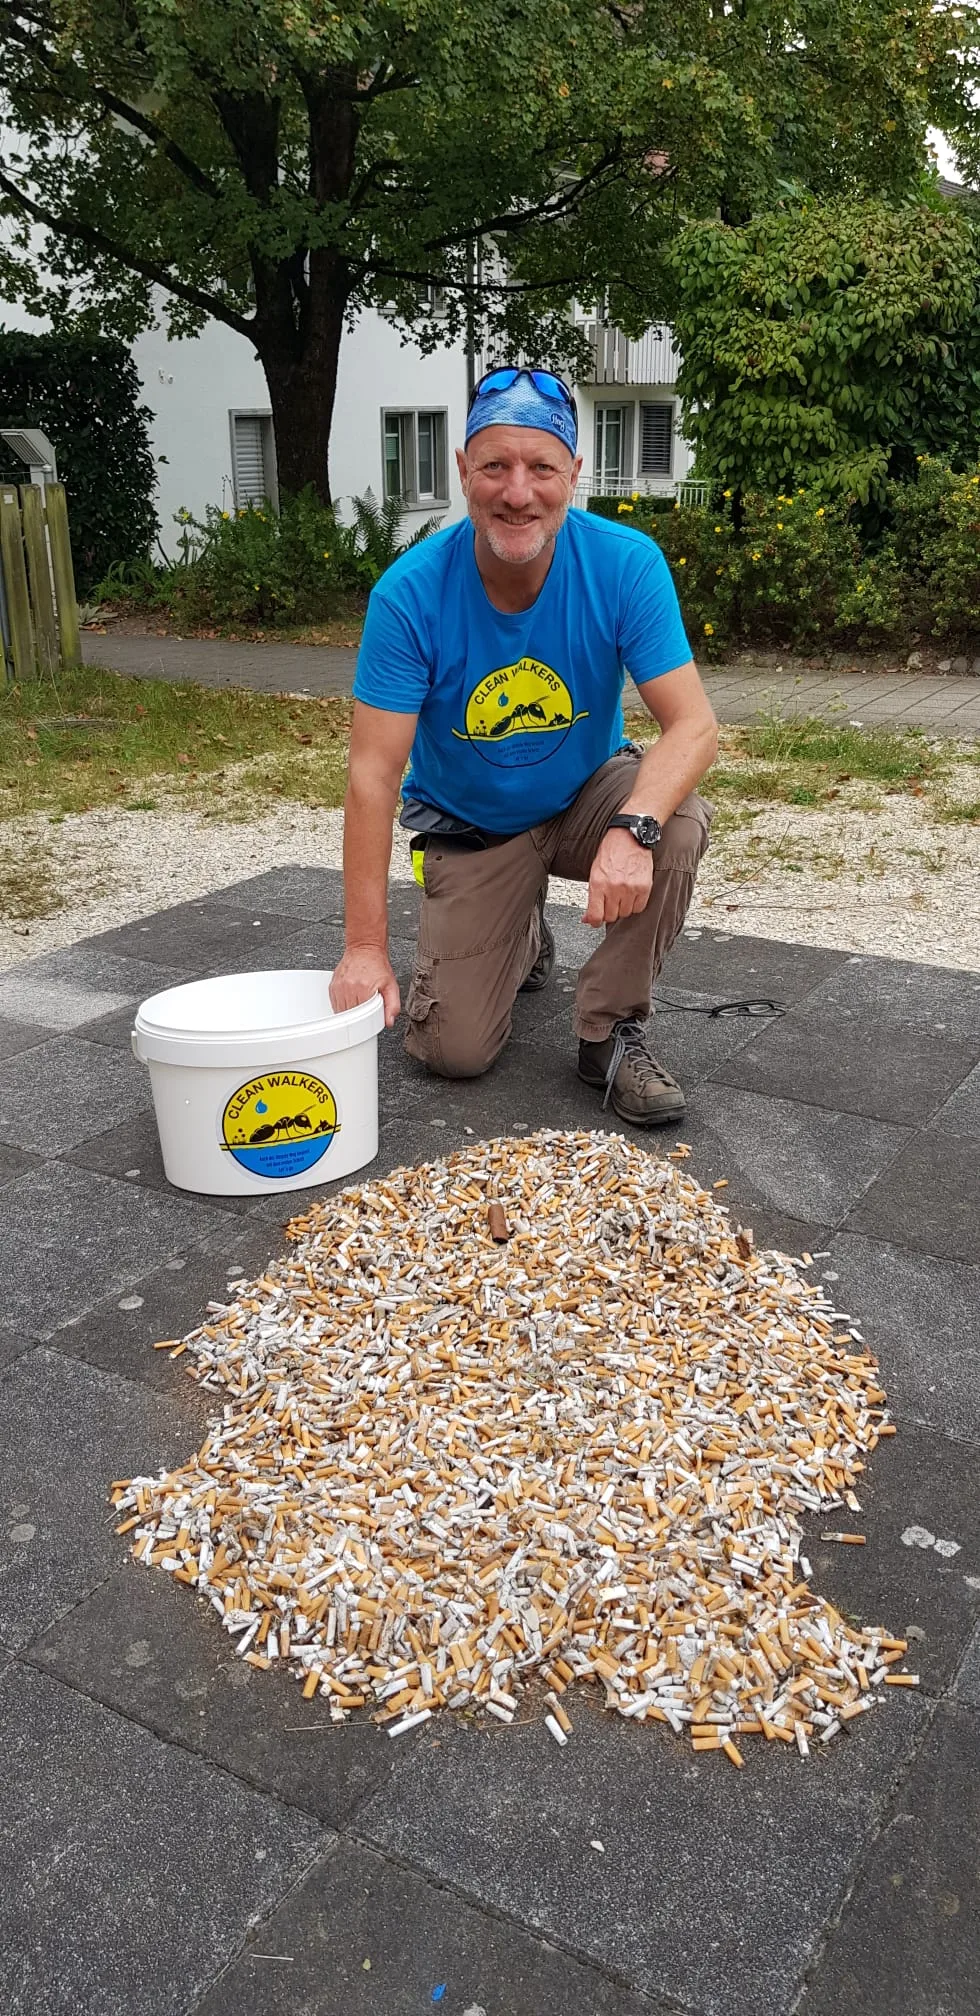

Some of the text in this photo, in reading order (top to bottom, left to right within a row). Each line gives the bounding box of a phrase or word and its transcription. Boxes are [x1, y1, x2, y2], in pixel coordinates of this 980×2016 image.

[474, 673, 509, 705] CLEAN
[228, 1075, 329, 1120] CLEAN WALKERS
